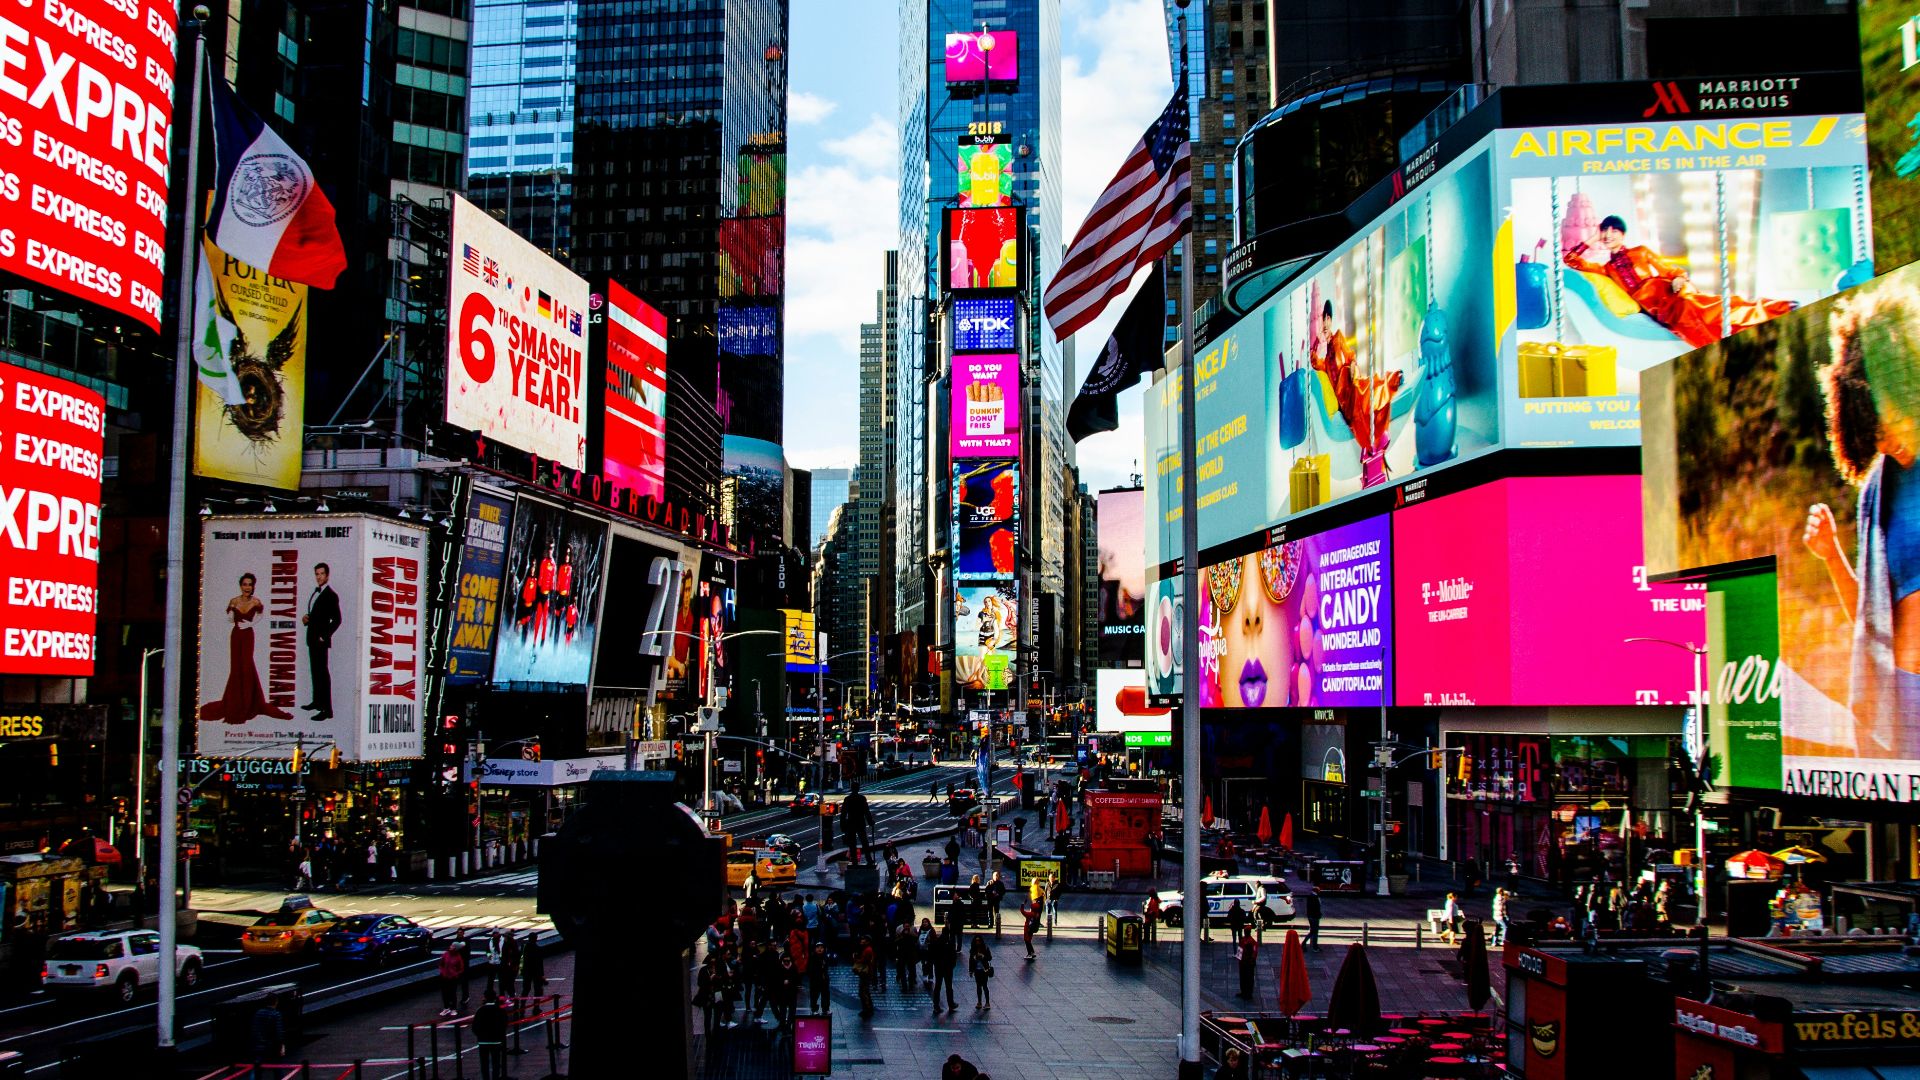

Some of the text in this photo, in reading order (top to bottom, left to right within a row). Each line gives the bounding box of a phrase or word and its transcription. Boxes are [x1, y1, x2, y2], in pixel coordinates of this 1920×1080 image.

[44, 0, 137, 70] EXPRESS
[0, 15, 172, 180] EXPRE
[1699, 77, 1801, 94] MARRIOTT
[1700, 94, 1789, 111] MARQUIS
[968, 121, 1002, 135] 2018
[1510, 120, 1792, 158] AIRFRANCE
[33, 129, 128, 197] EXPRESS
[1405, 141, 1439, 175] MARRIOTT
[1583, 154, 1768, 173] FRANCE IS IN THE AIR
[1406, 160, 1436, 190] MARQUIS
[31, 184, 126, 247] EXPRESS
[26, 238, 122, 298] EXPRESS
[1226, 240, 1257, 268] MARRIOTT
[230, 283, 288, 308] CURSED CHILD
[970, 317, 1010, 331] TDK
[969, 364, 1002, 372] DO YOU
[973, 371, 998, 379] WANT
[508, 349, 581, 424] YEAR!
[15, 382, 100, 433] EXPRESS
[970, 407, 1002, 415] DUNKIN'
[1524, 401, 1593, 414] PUTTING
[1595, 400, 1631, 412] YOU
[960, 439, 1011, 448] WITH THAT?
[1220, 414, 1247, 445] CENTER
[15, 432, 98, 480] EXPRESS
[1199, 455, 1224, 482] WORLD
[0, 484, 101, 563] XPRE
[976, 506, 996, 516] UGG
[1320, 539, 1381, 568] AN OUTRAGEOUSLY
[270, 549, 298, 620] PRETTY
[460, 572, 499, 600] COME
[1320, 561, 1381, 592] INTERACTIVE
[8, 576, 92, 613] EXPRESS
[1320, 585, 1382, 630] CANDY
[1651, 599, 1679, 612] THE
[369, 556, 396, 695] WOMAN
[392, 557, 418, 701] PRETTY
[452, 622, 493, 650] AWAY
[1104, 625, 1132, 635] MUSIC
[1321, 627, 1381, 651] WONDERLAND
[4, 627, 90, 660] EXPRESS
[269, 630, 296, 708] WOMAN
[1322, 675, 1382, 692] CANDYTOPIA.COM
[369, 703, 415, 734] THE MUSICAL
[380, 741, 415, 750] BROADWAY
[158, 759, 210, 773] FTS
[517, 768, 538, 777] store
[1784, 767, 1904, 803] AMERICAN
[1677, 1009, 1716, 1033] belgian
[1794, 1012, 1920, 1041] wafels &
